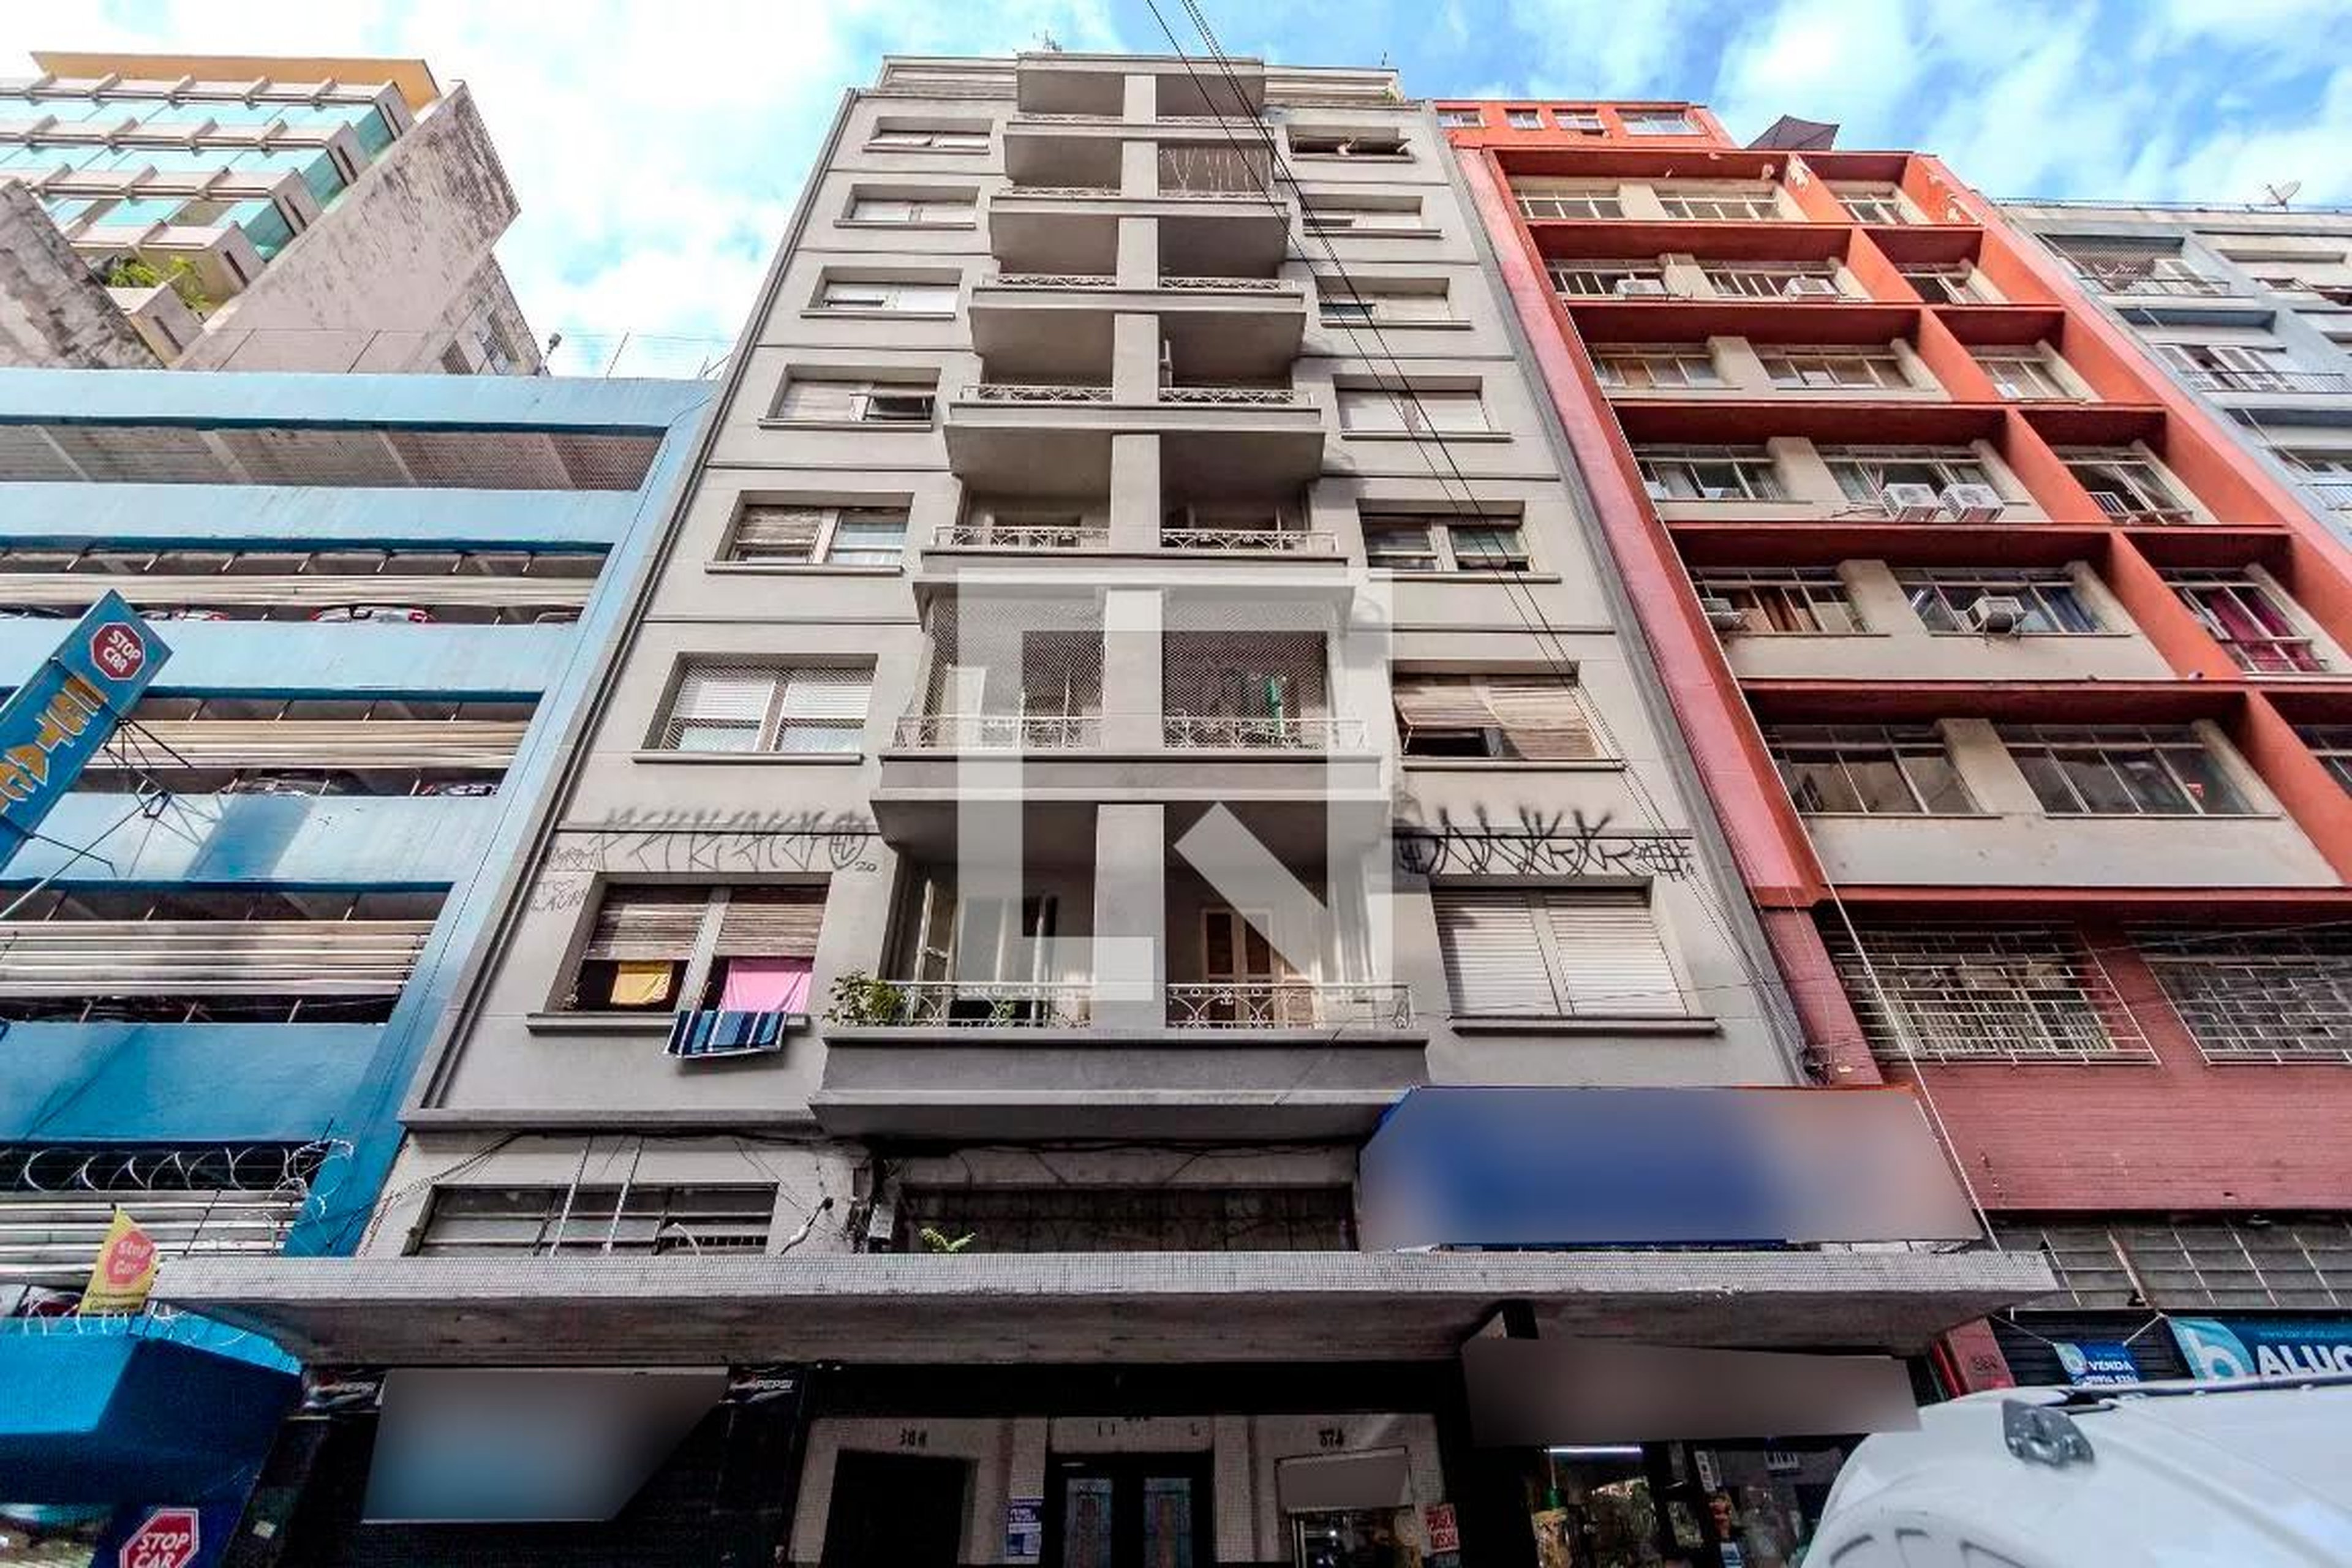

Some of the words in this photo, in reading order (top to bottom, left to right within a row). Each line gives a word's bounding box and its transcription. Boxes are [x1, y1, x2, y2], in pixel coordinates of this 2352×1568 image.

[108, 630, 141, 660] STOP
[103, 647, 128, 673] CAR
[0, 672, 109, 816] ESTAC
[2088, 1359, 2135, 1371] VENDA
[137, 1532, 190, 1551] STOP
[132, 1551, 176, 1568] CAR
